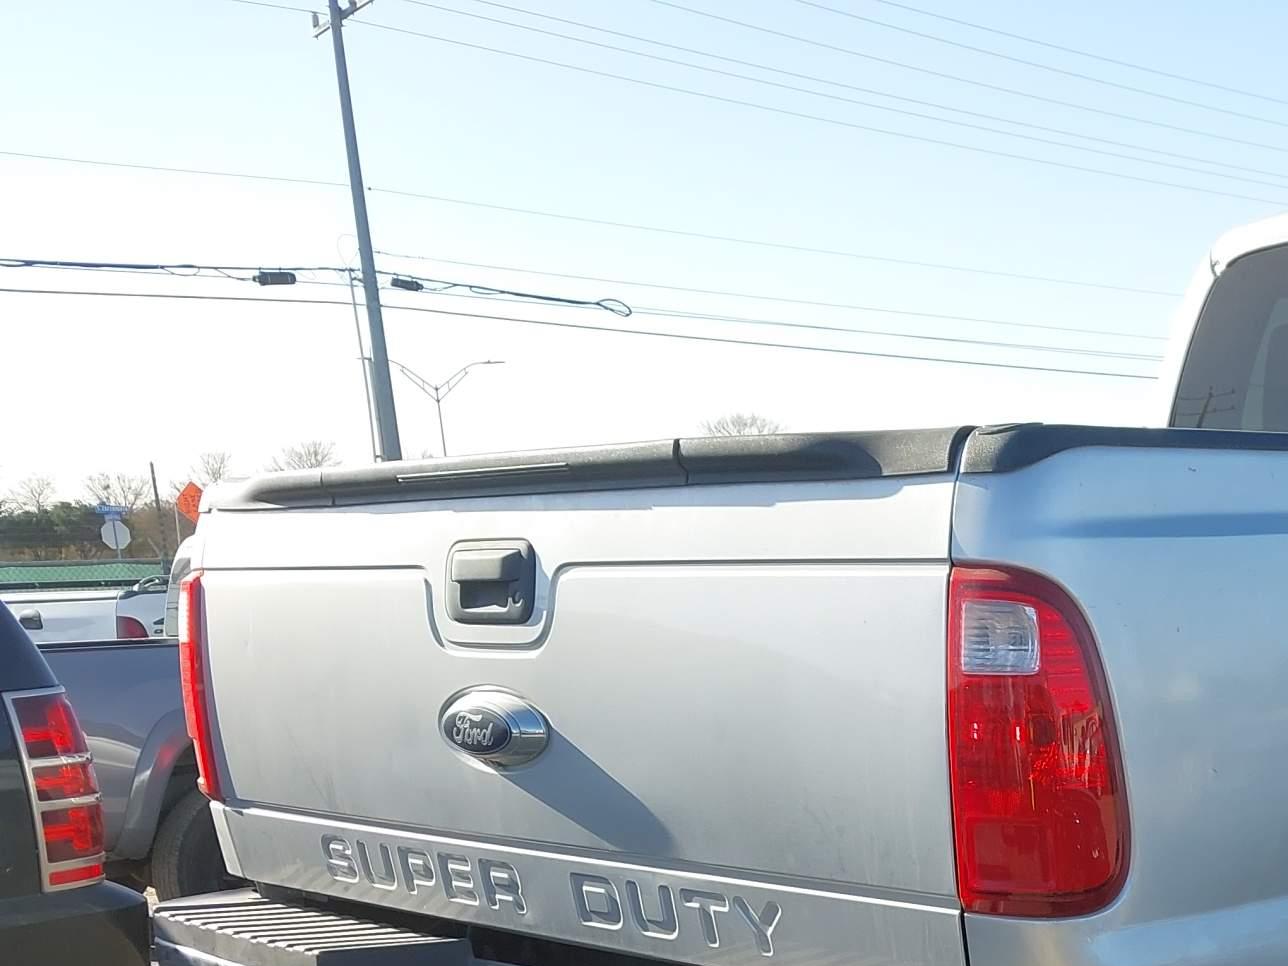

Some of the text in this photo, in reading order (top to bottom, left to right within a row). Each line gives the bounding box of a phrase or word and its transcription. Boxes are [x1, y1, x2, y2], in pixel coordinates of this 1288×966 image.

[452, 711, 495, 746] Ford
[320, 833, 783, 958] SUPER DUTY
